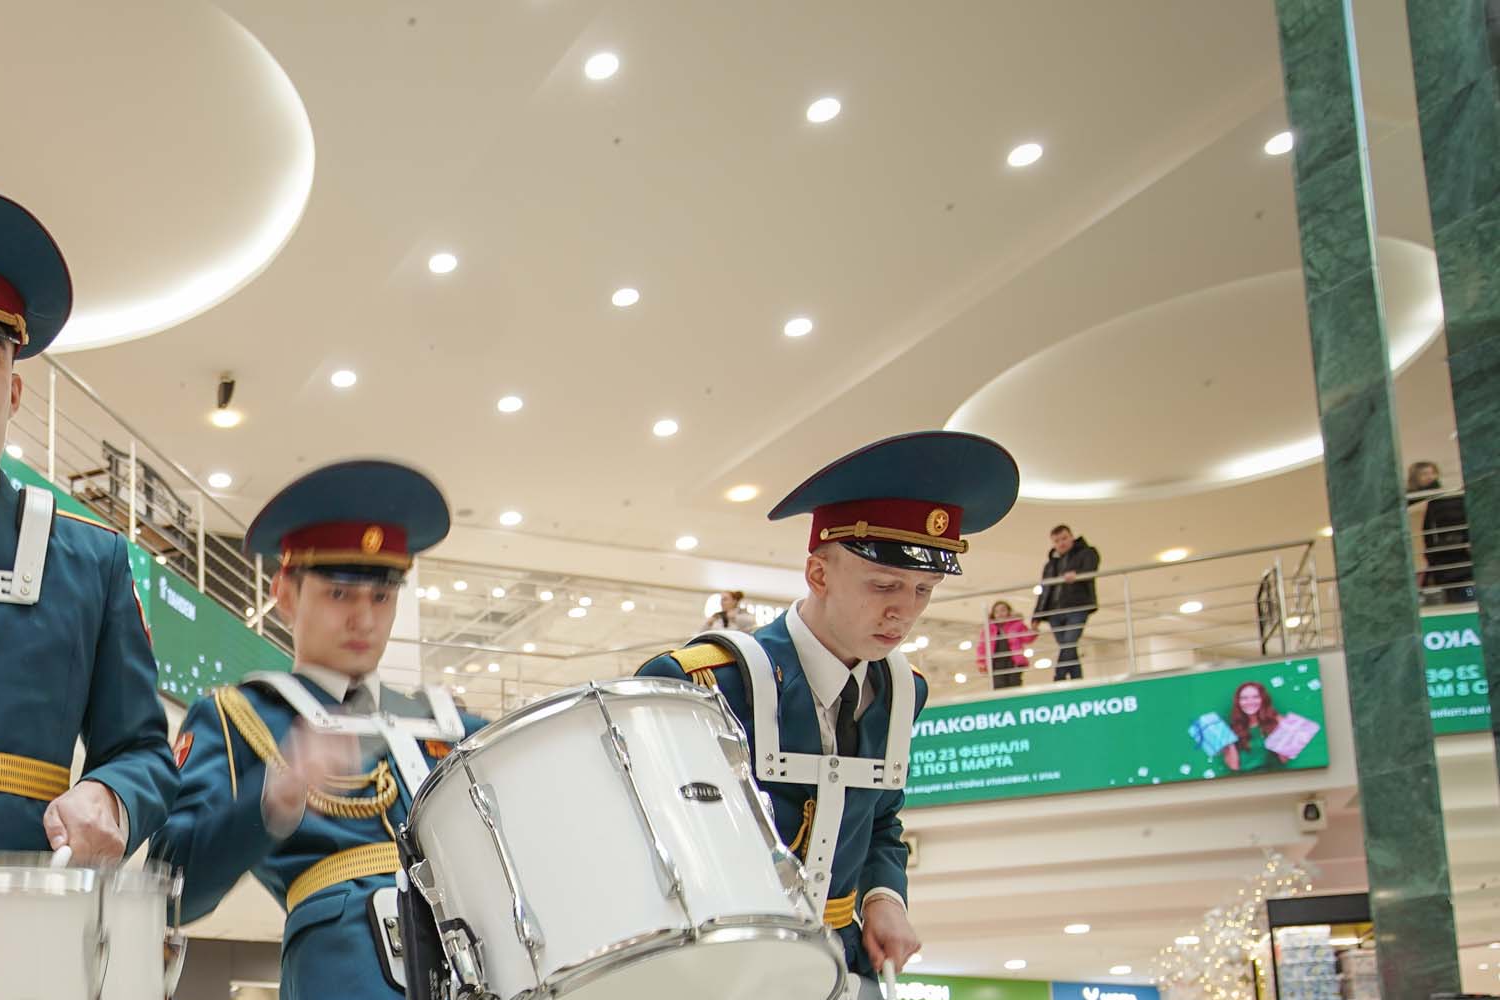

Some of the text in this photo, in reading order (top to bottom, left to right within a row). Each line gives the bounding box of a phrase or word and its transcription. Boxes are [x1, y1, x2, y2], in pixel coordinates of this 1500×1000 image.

[1019, 696, 1138, 725] ПОДАРКОВ
[913, 739, 1030, 763] ПО 23 ФЕВРАЛЯ
[923, 761, 947, 776] ПО
[961, 754, 1013, 772] МАРТА
